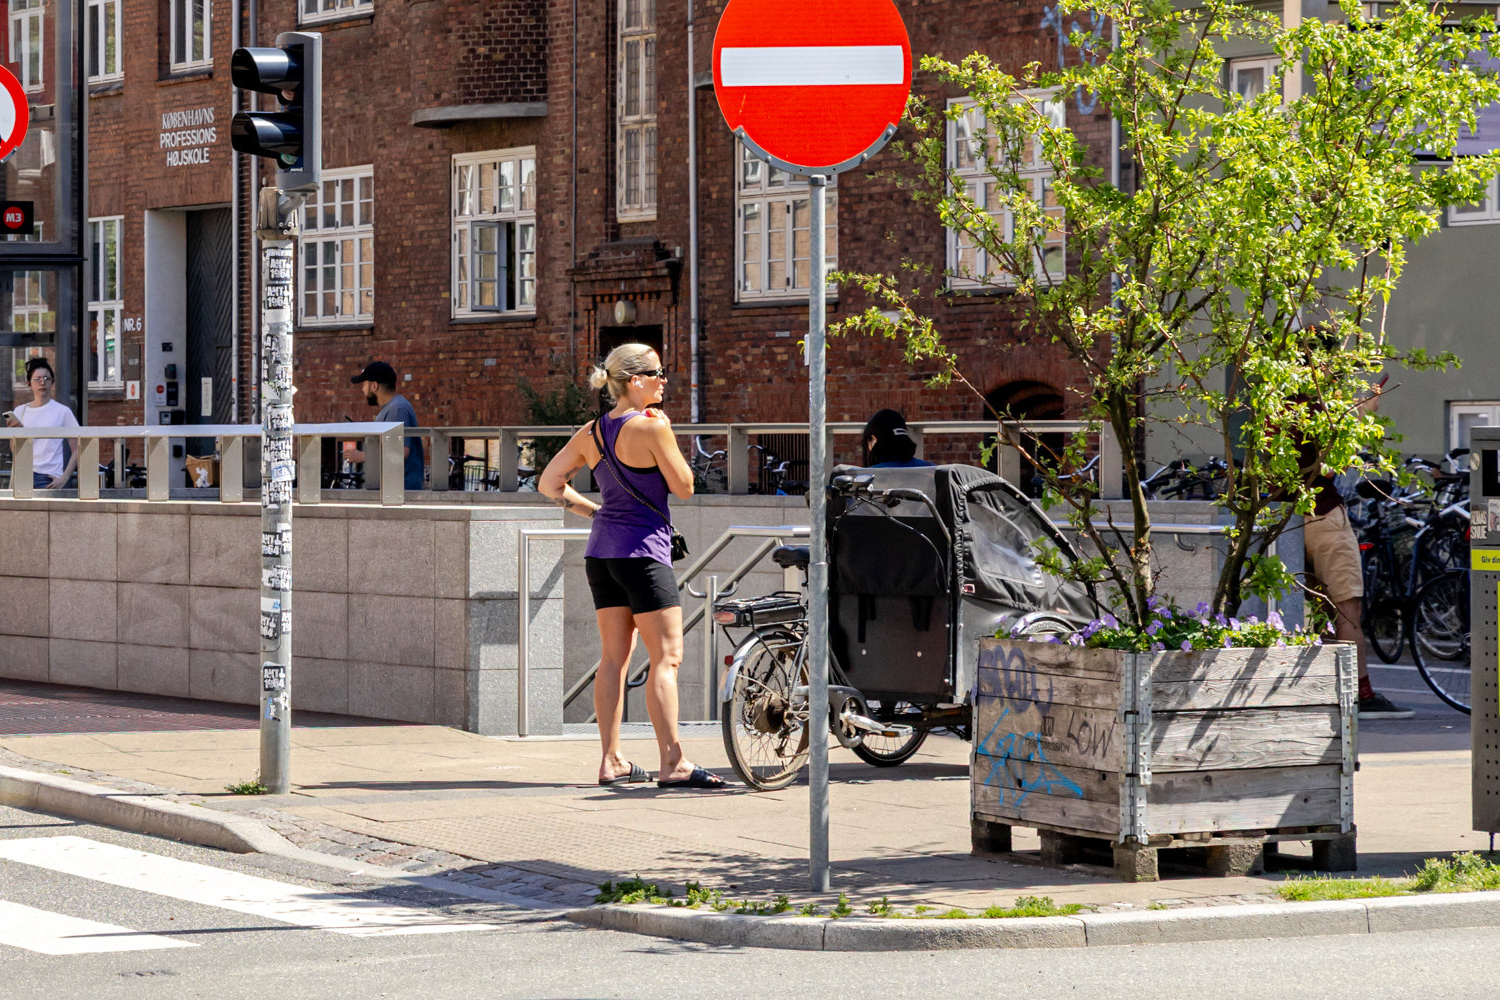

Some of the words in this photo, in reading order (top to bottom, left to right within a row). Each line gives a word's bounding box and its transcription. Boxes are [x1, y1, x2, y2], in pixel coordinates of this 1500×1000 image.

[162, 107, 215, 130] KØBENHAVNS
[160, 127, 217, 149] PROFESSIONS
[166, 147, 210, 168] HØJSKOLE
[6, 212, 22, 223] M3
[136, 316, 142, 331] 6
